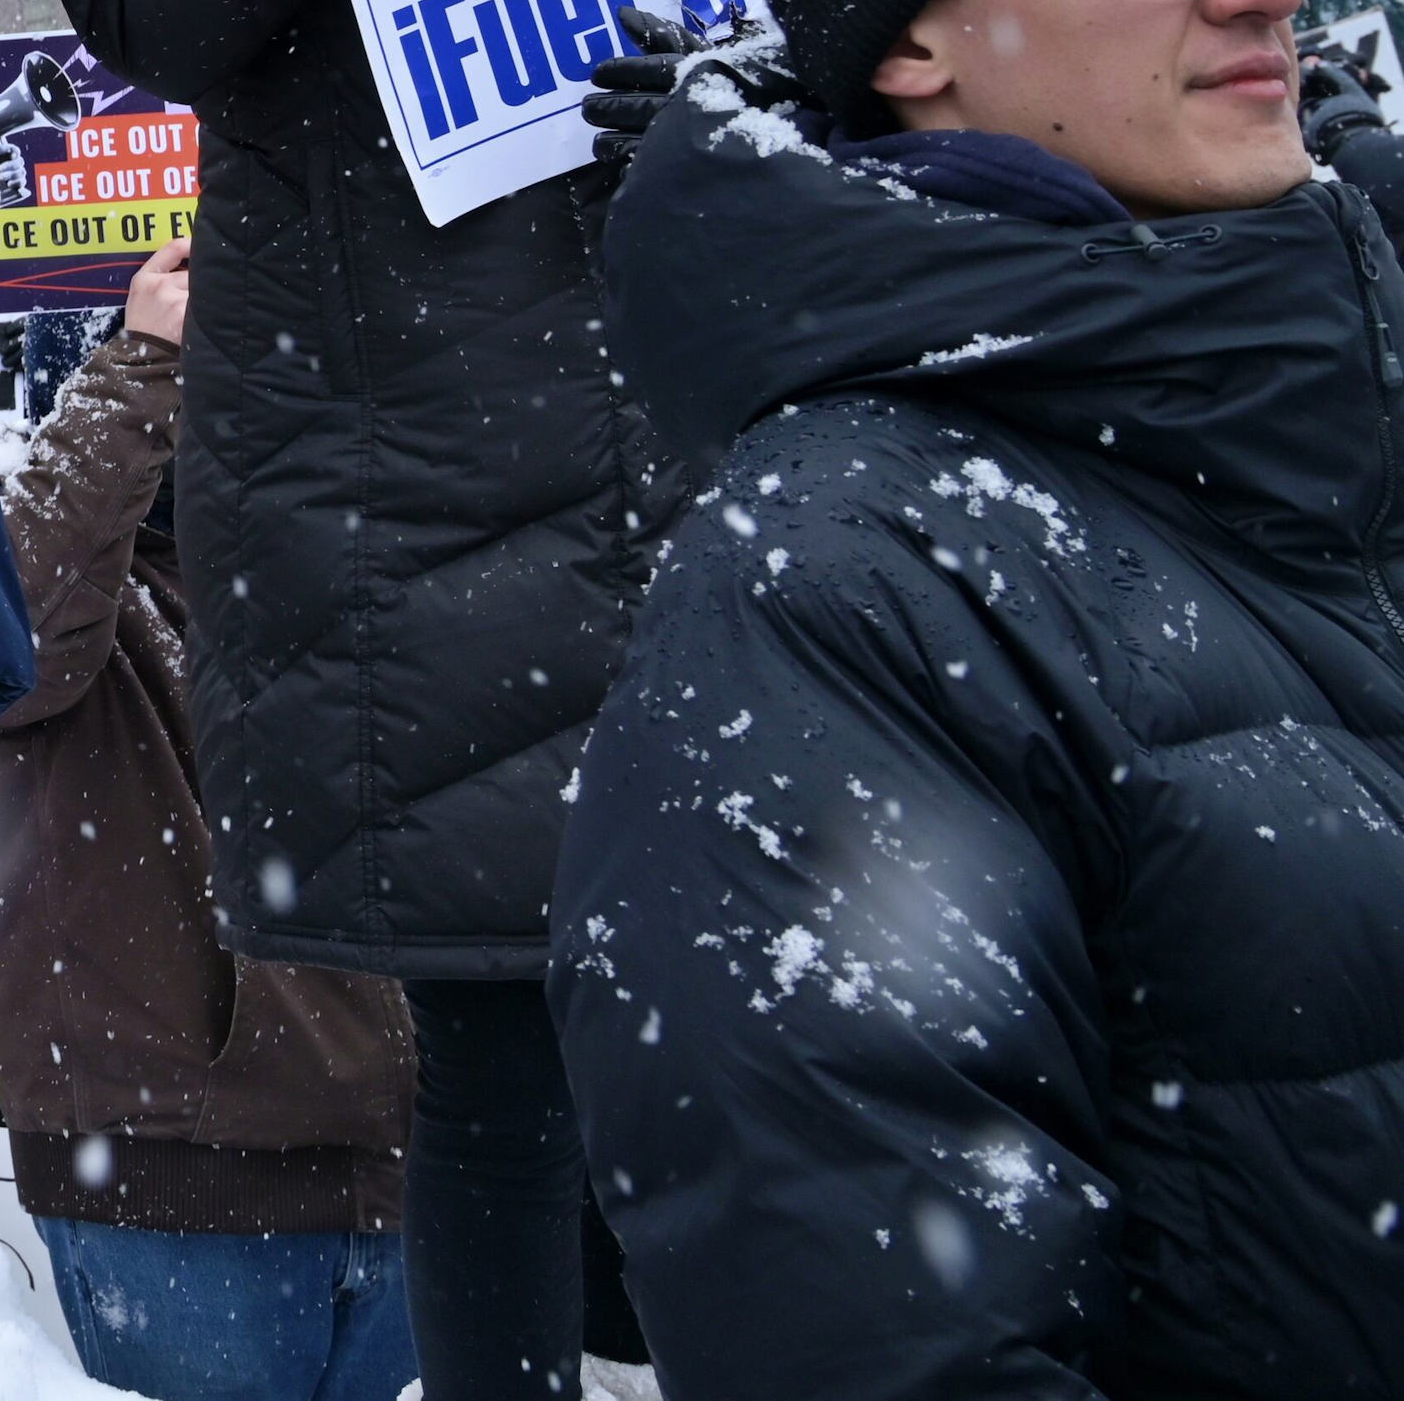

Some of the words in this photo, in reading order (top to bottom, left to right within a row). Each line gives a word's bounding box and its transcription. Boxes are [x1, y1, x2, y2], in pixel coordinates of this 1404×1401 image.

[69, 127, 116, 159] ICE
[128, 123, 183, 153] OUT
[39, 171, 86, 203] ICE
[96, 168, 152, 200] OUT
[163, 166, 196, 195] OF
[50, 216, 107, 246] OUT
[121, 213, 157, 242] OF
